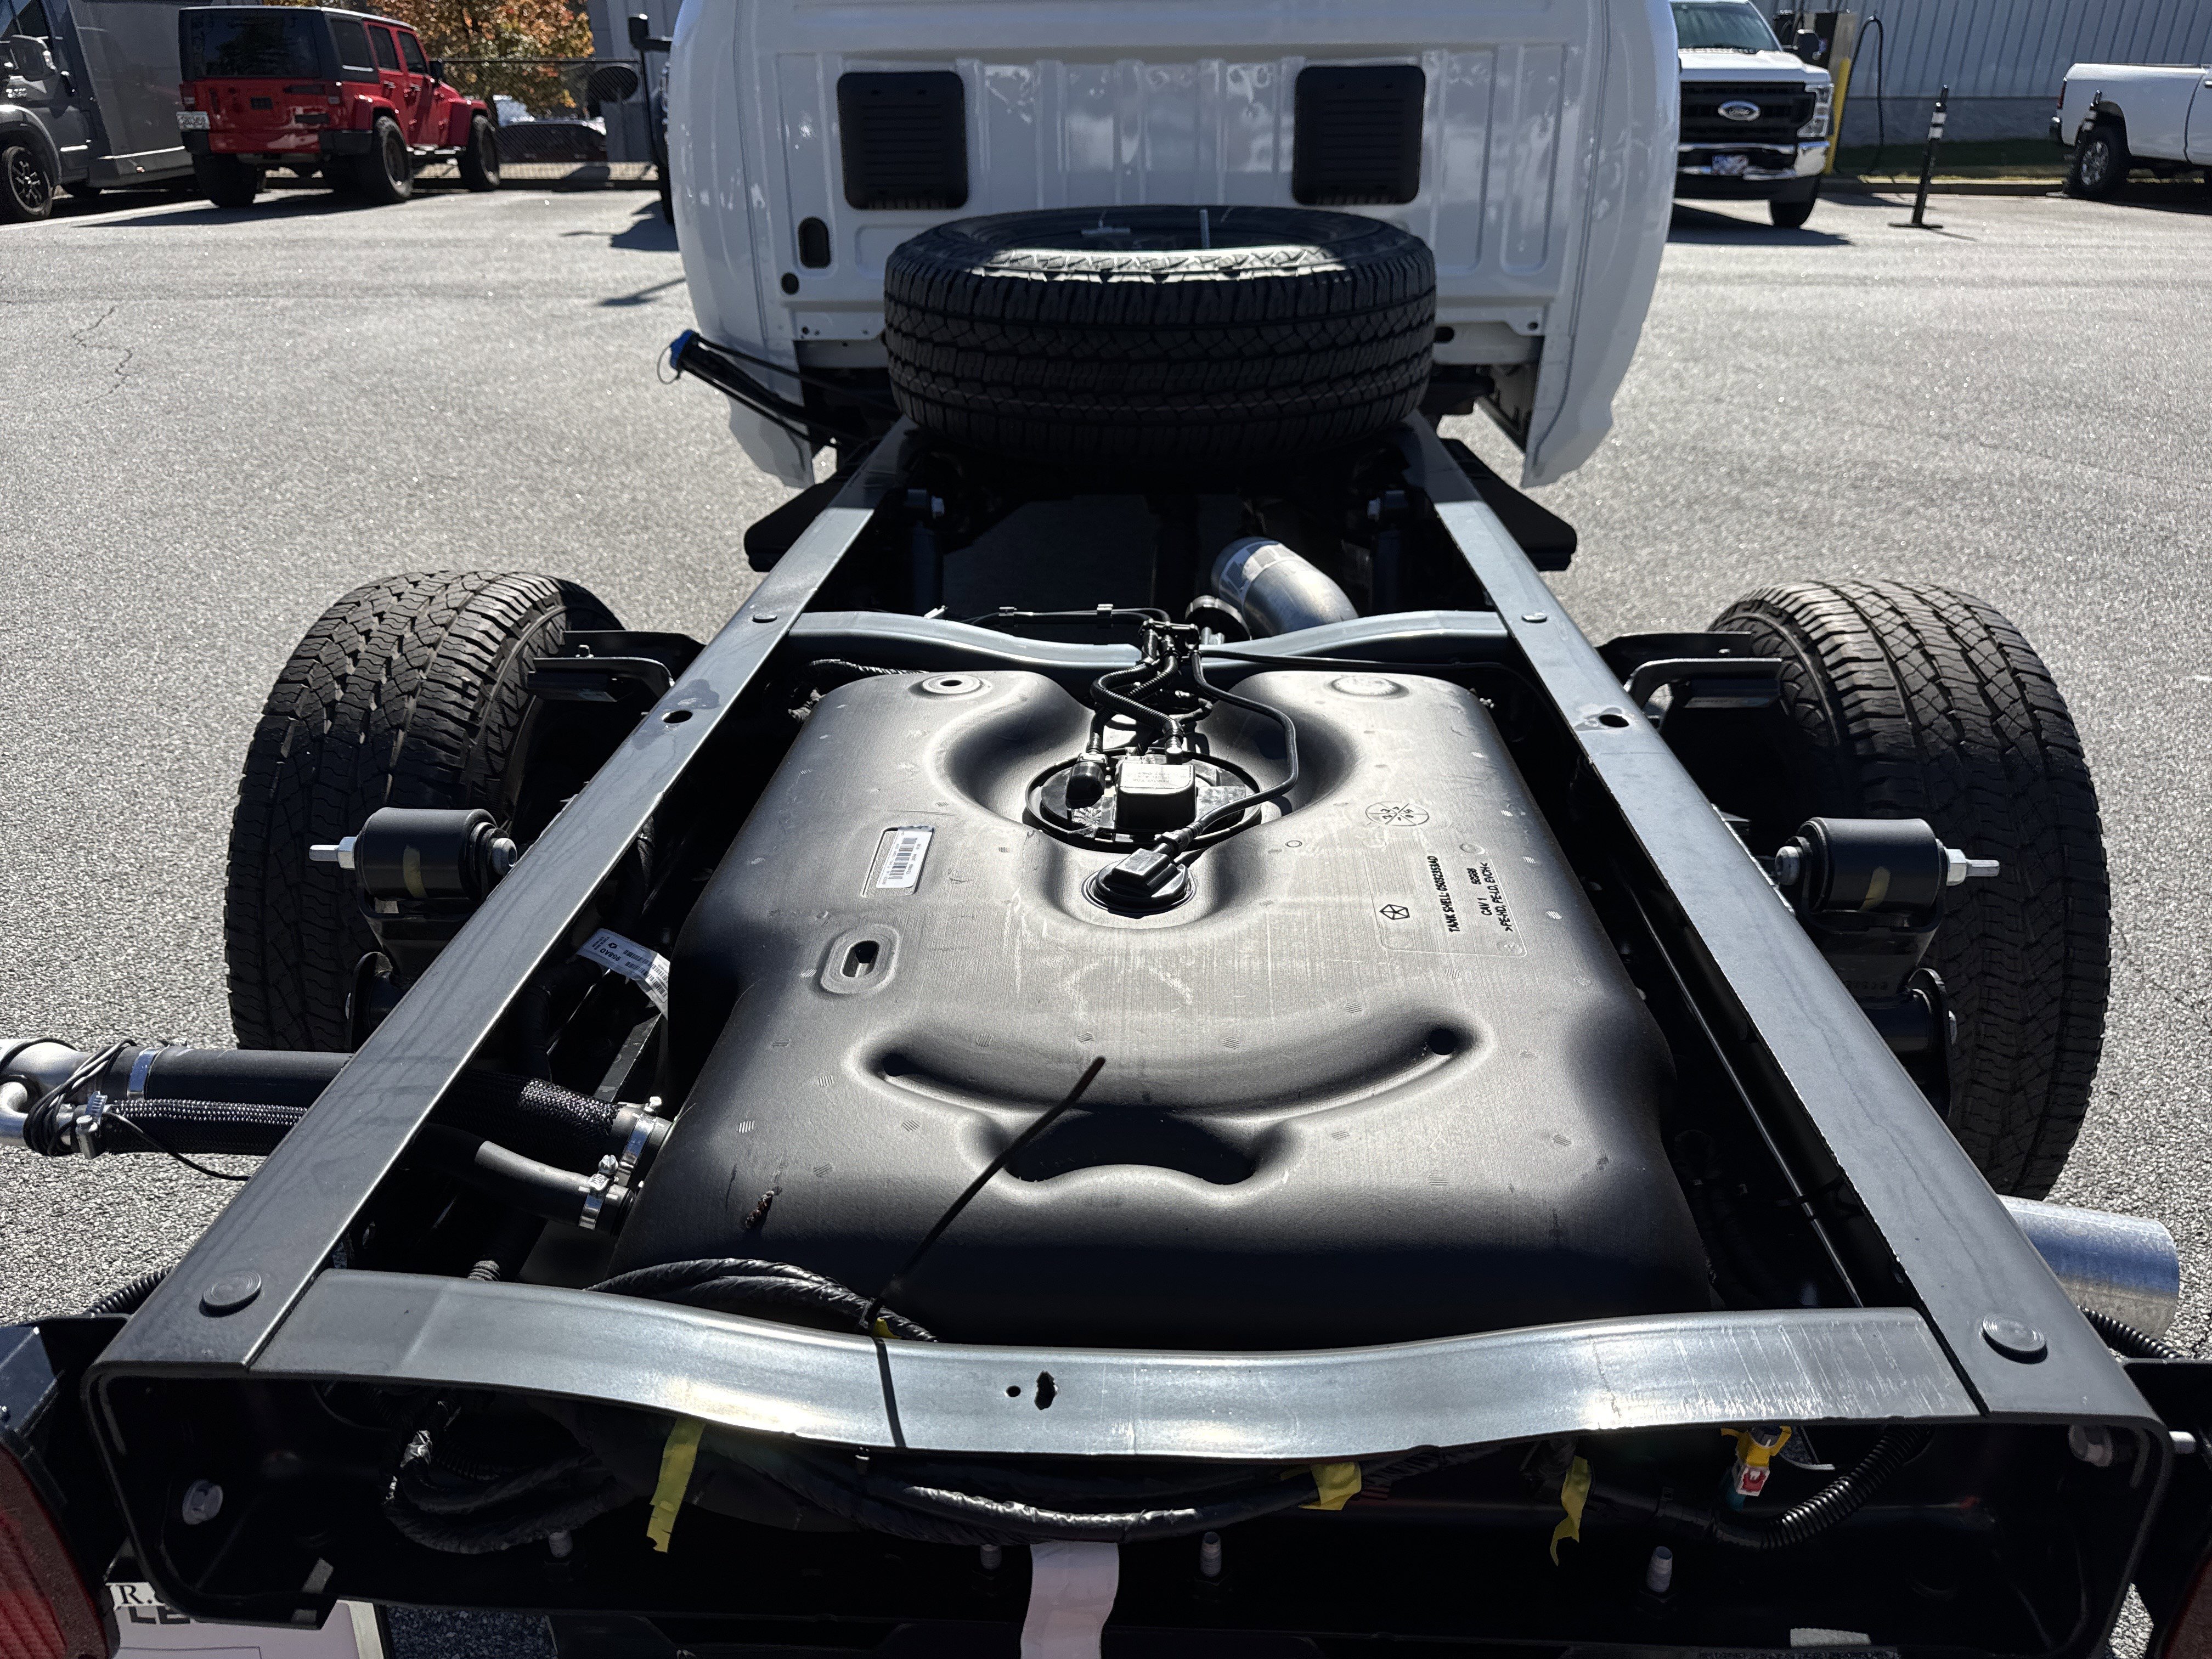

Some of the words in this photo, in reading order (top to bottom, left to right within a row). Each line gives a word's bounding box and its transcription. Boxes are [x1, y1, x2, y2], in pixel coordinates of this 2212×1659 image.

[1478, 901, 1492, 916] CAV
[1444, 913, 1460, 932] TANK
[600, 948, 622, 961] 958AD
